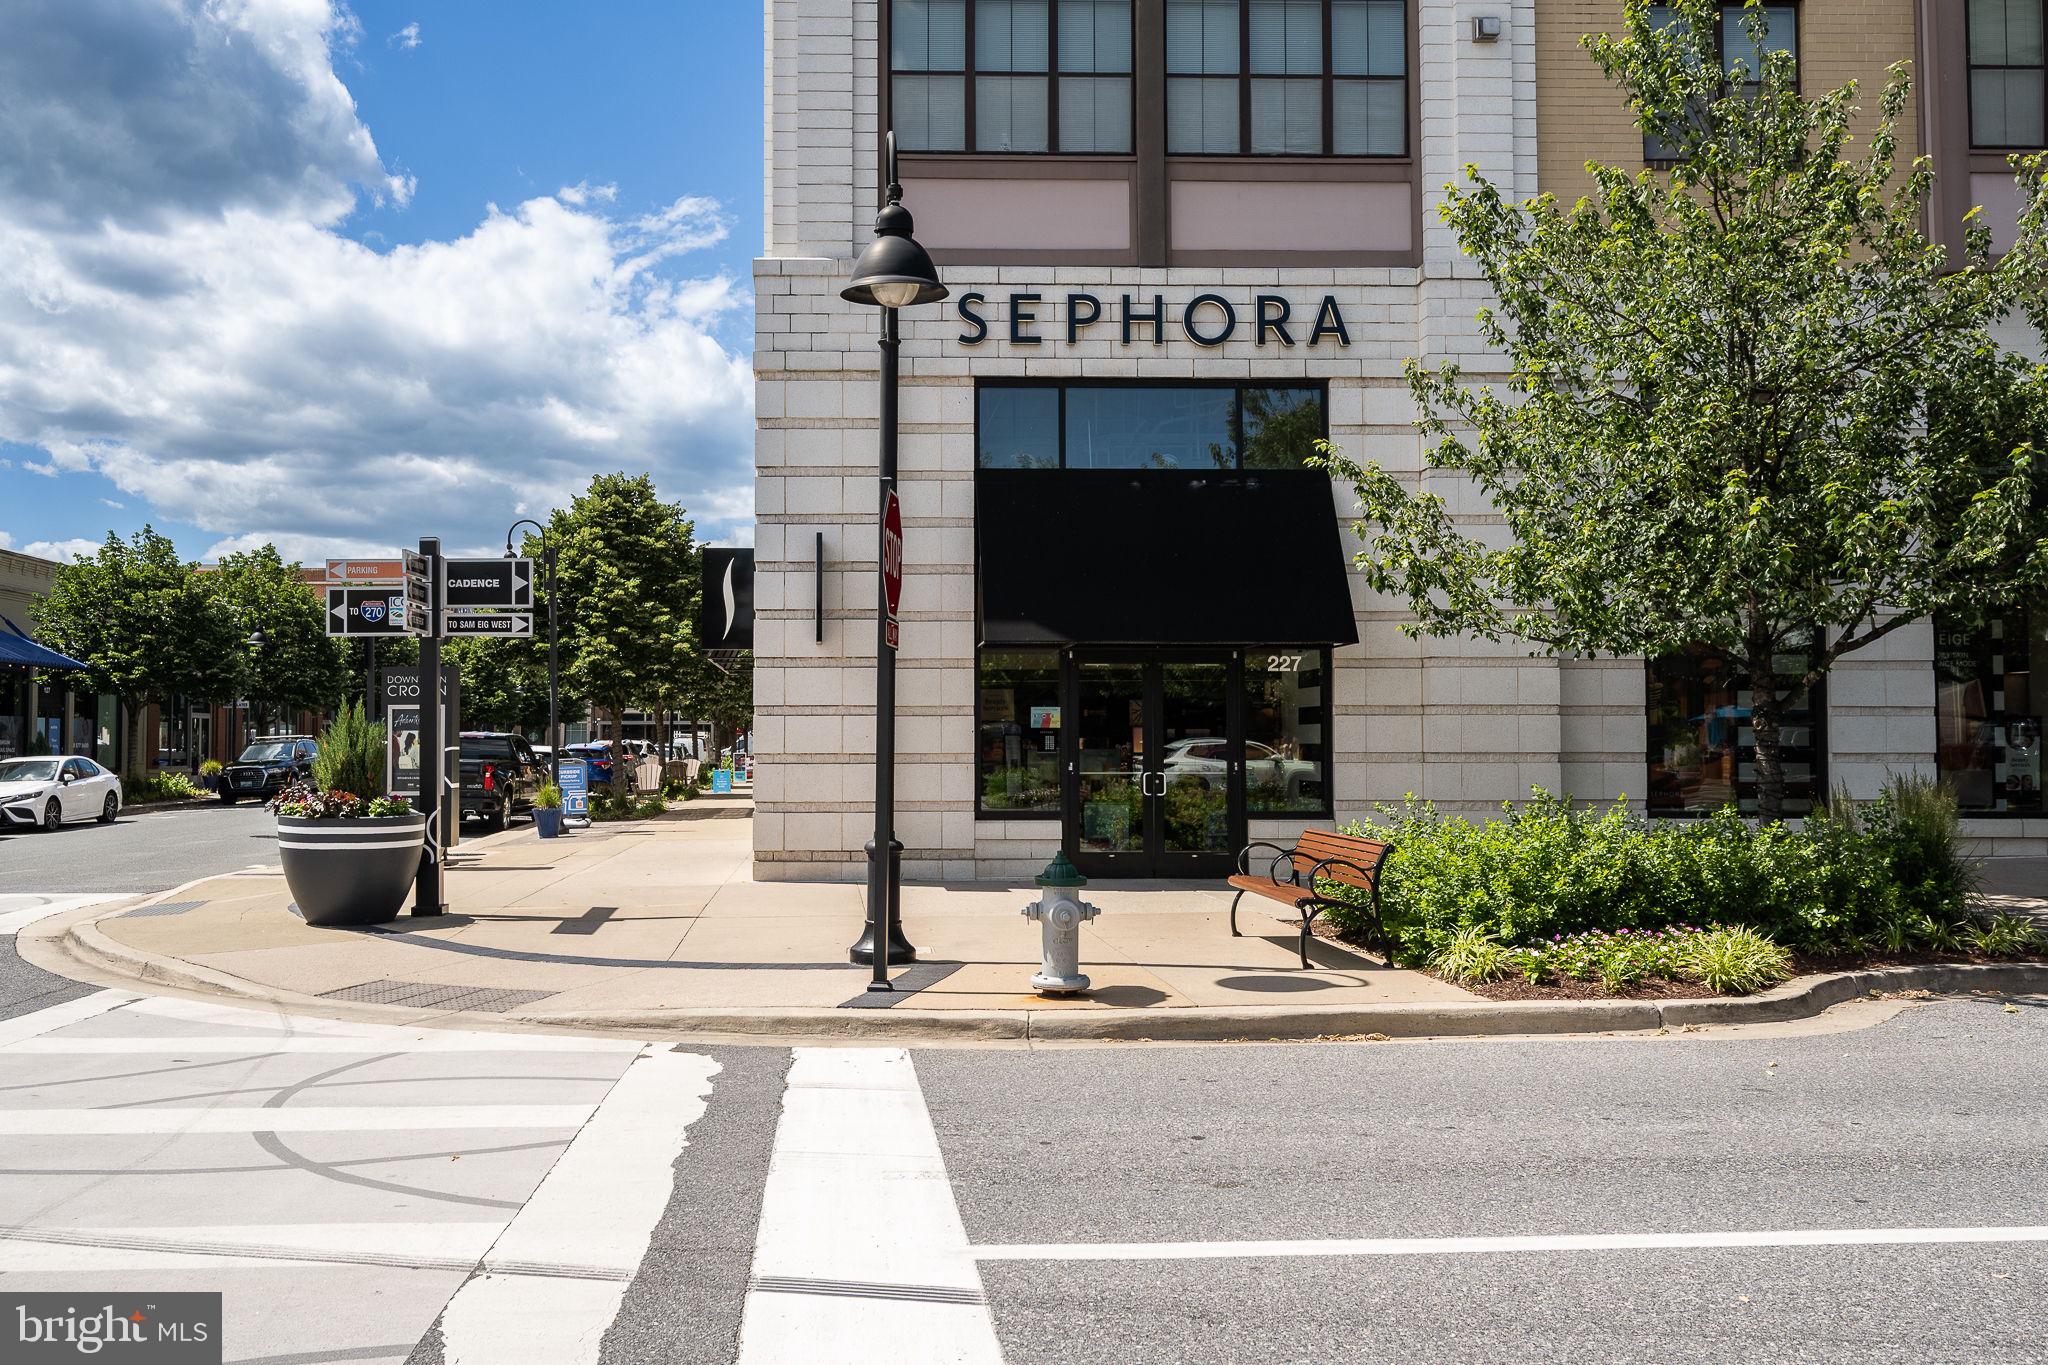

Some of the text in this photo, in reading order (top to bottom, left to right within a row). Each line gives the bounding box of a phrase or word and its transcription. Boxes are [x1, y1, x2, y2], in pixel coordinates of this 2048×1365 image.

[957, 292, 1351, 348] SEPHORA
[885, 527, 901, 579] STOP
[347, 566, 378, 574] PARKING
[448, 578, 500, 588] CADENCE
[349, 607, 359, 616] TO
[365, 607, 383, 618] 270
[448, 620, 511, 628] TO SAM EIG WEST
[1267, 655, 1302, 672] 227
[387, 675, 447, 684] DOWNN
[387, 684, 447, 697] CRON
